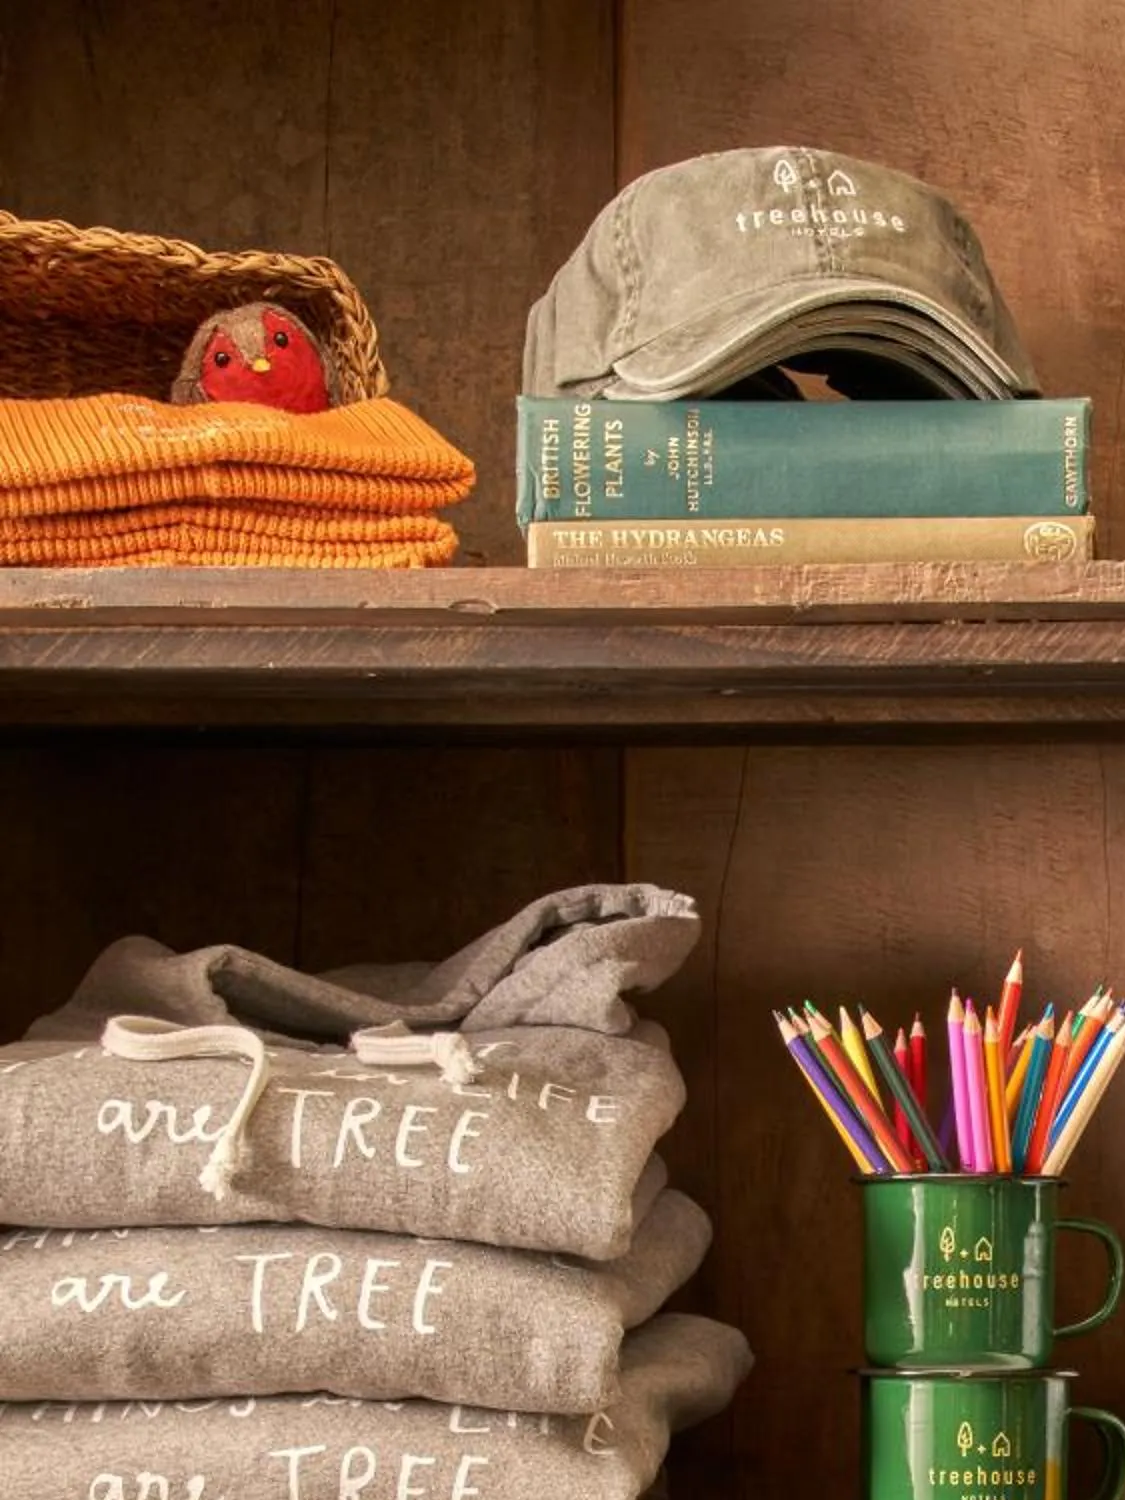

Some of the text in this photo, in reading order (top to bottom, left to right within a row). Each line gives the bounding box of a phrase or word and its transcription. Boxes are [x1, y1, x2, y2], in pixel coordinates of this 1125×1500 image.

[735, 203, 906, 232] treehouse
[542, 418, 561, 499] BRITISH
[573, 402, 593, 518] FLOWERING
[604, 413, 624, 498] PLANTS
[643, 448, 661, 467] by
[667, 436, 681, 481] JOHN
[552, 527, 785, 549] THE HYDRANGEAS
[97, 1087, 490, 1174] are TREE
[50, 1252, 454, 1334] are TREE
[928, 1465, 1037, 1486] treehouse
